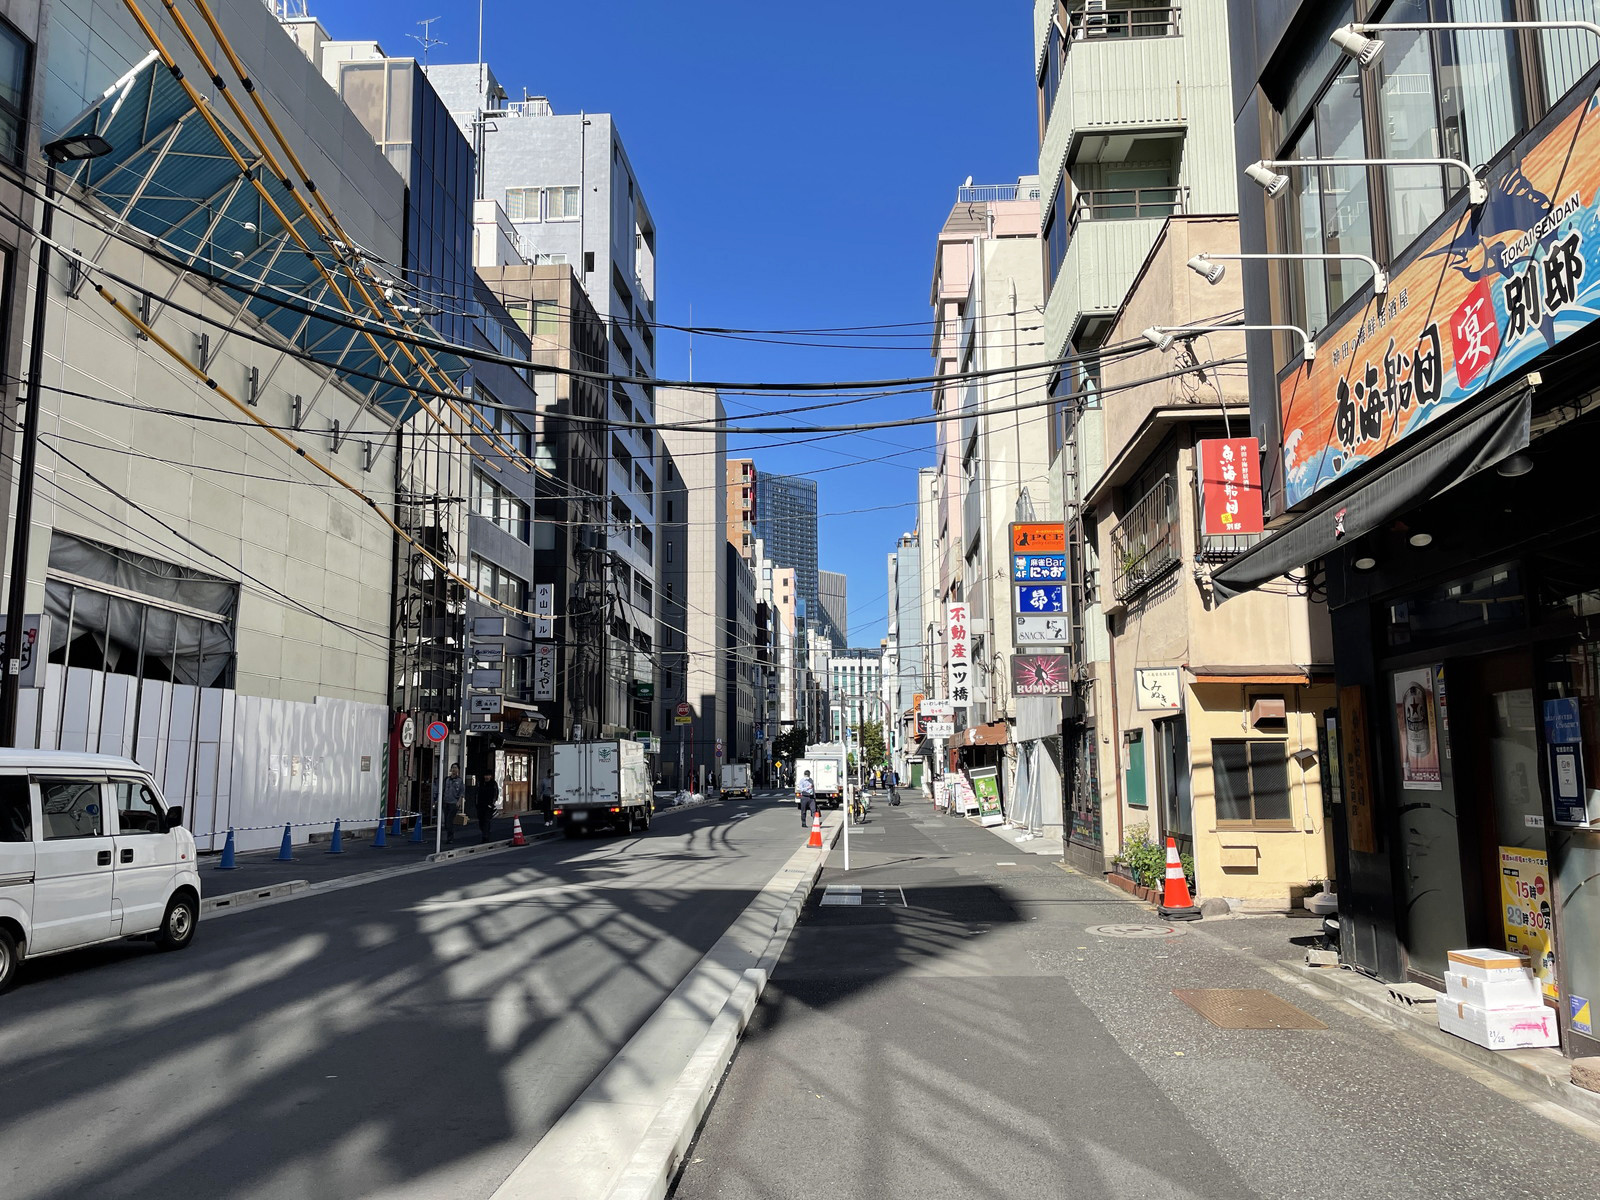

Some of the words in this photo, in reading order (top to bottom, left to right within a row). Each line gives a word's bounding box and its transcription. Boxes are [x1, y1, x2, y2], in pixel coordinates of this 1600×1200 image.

[1501, 231, 1533, 267] TOKAI
[1535, 193, 1580, 240] SENDAN
[1456, 296, 1496, 369] 宴
[1505, 233, 1584, 345] 別邸
[1015, 570, 1027, 578] 4F
[1030, 566, 1063, 578] にゃお
[539, 587, 548, 634] 小山ビル
[1018, 631, 1046, 641] SNACK
[949, 606, 969, 702] 不動産一ツ橋
[1515, 880, 1537, 900] 15時
